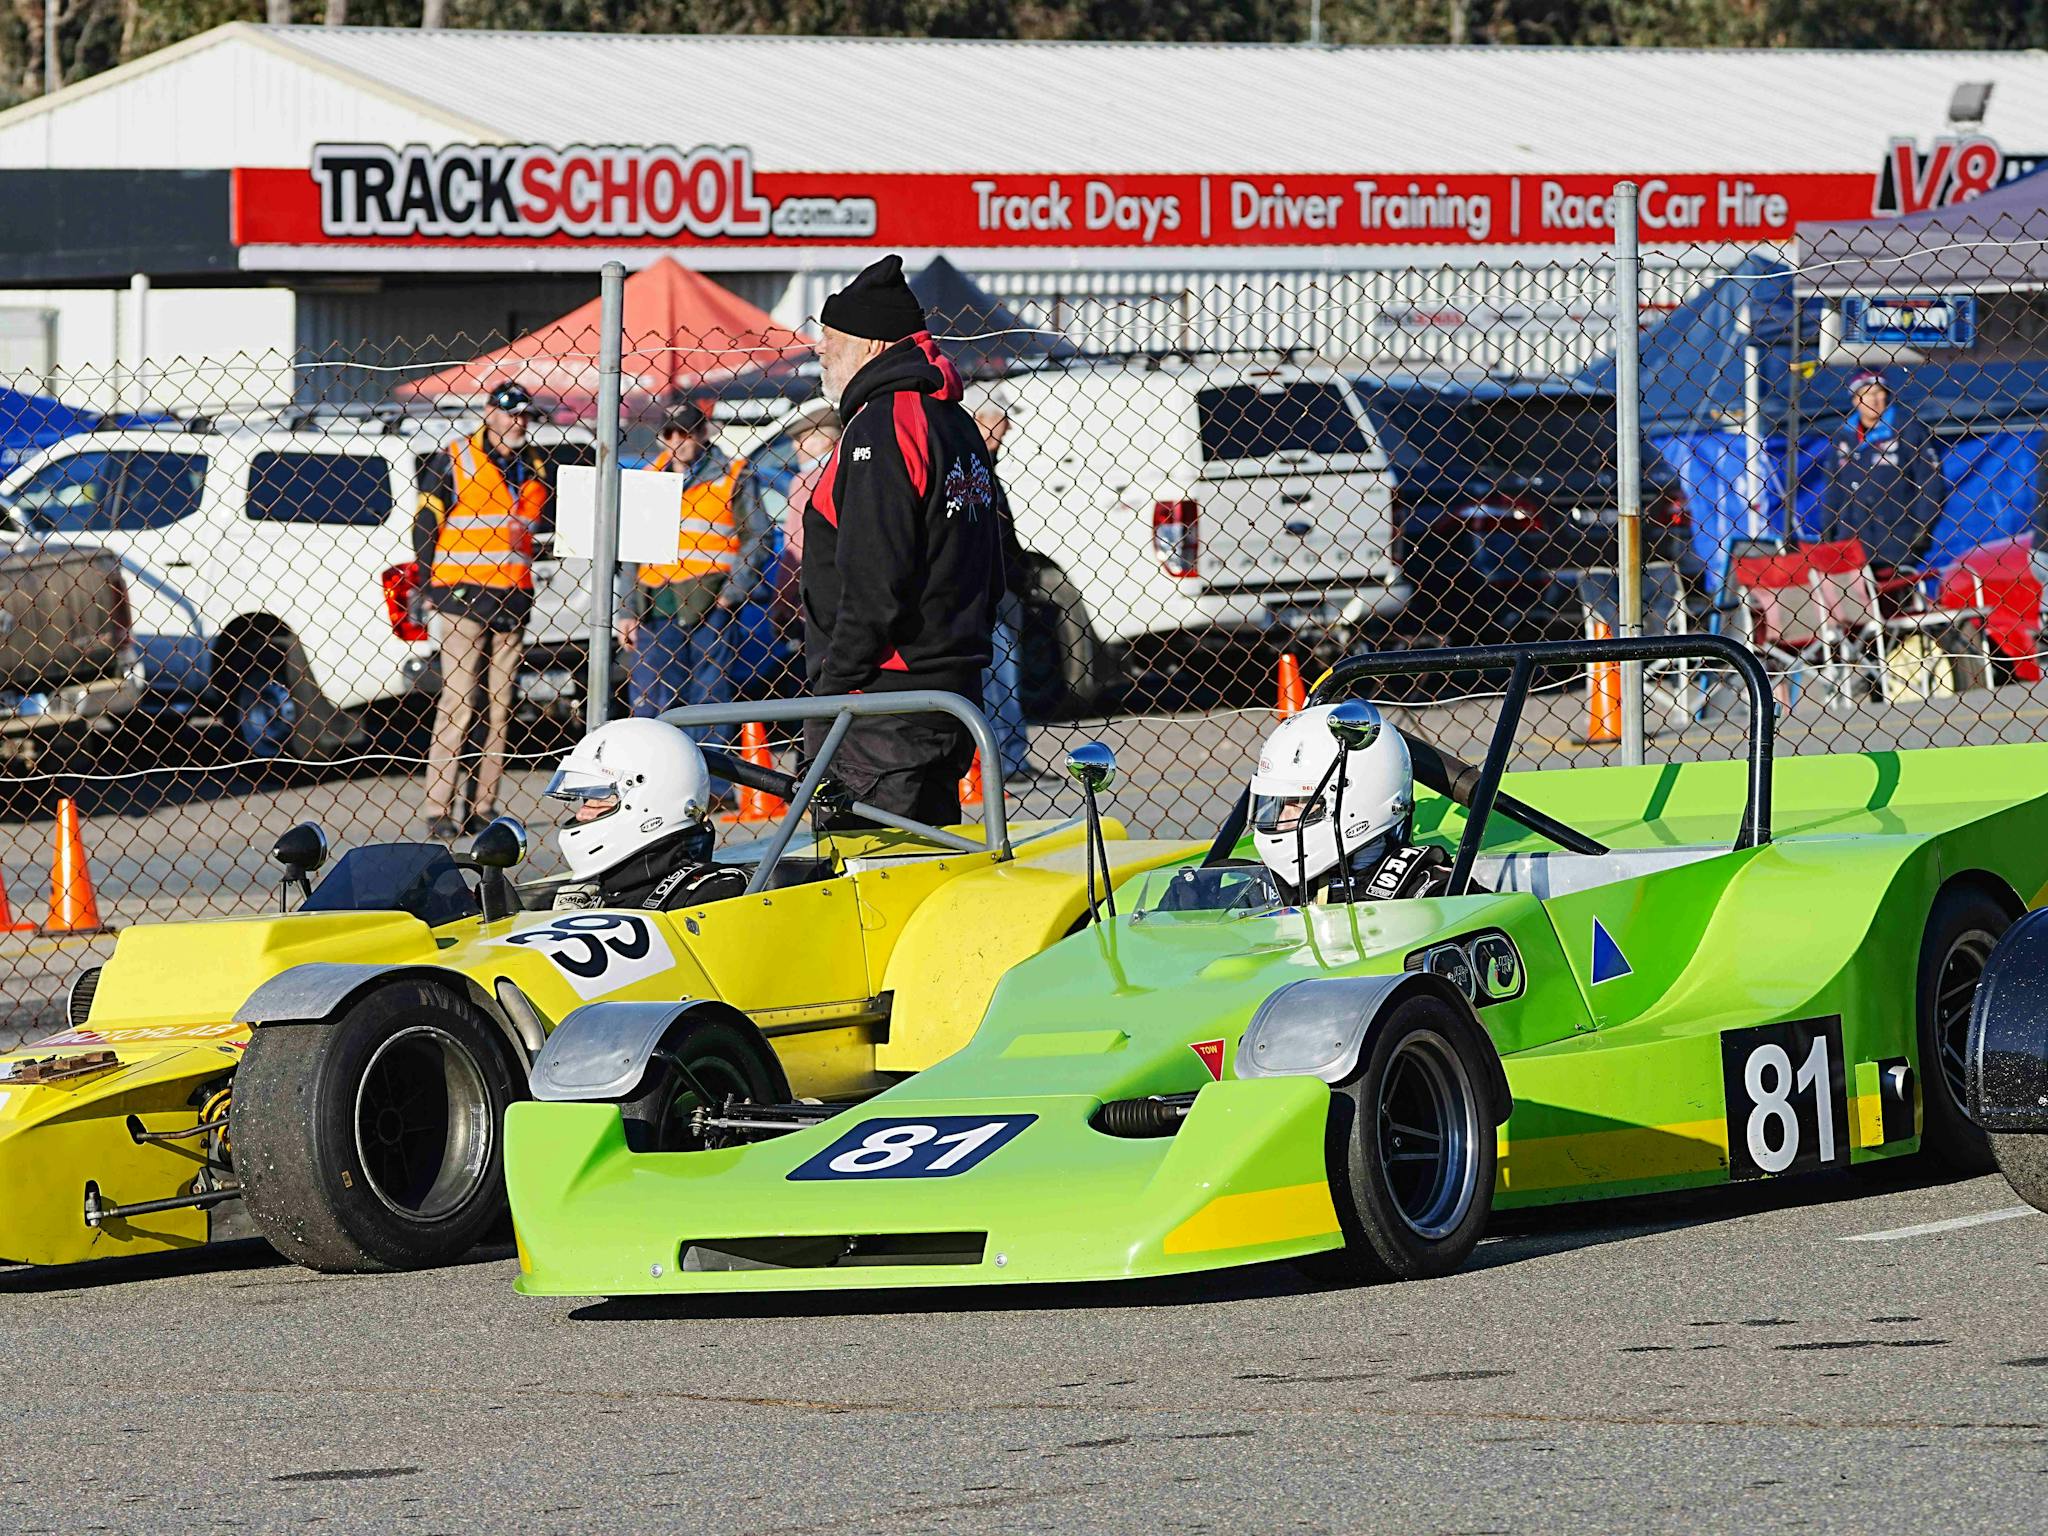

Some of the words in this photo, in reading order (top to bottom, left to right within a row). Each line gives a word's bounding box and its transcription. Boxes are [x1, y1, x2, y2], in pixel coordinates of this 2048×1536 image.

[320, 156, 763, 224] TRACKSCHOOL
[971, 181, 1073, 231] Track
[1085, 181, 1181, 242] Days
[1231, 180, 1343, 230] Driver
[1354, 181, 1492, 241] Training
[1541, 181, 1616, 228] Race
[1639, 180, 1706, 228] Car
[1718, 181, 1788, 227] Hire
[852, 447, 871, 461] #95
[1376, 847, 1420, 889] TRS
[505, 914, 651, 979] 39
[1200, 1045, 1218, 1055] TOW
[1744, 1034, 1836, 1173] 81
[829, 1122, 1009, 1173] 81
